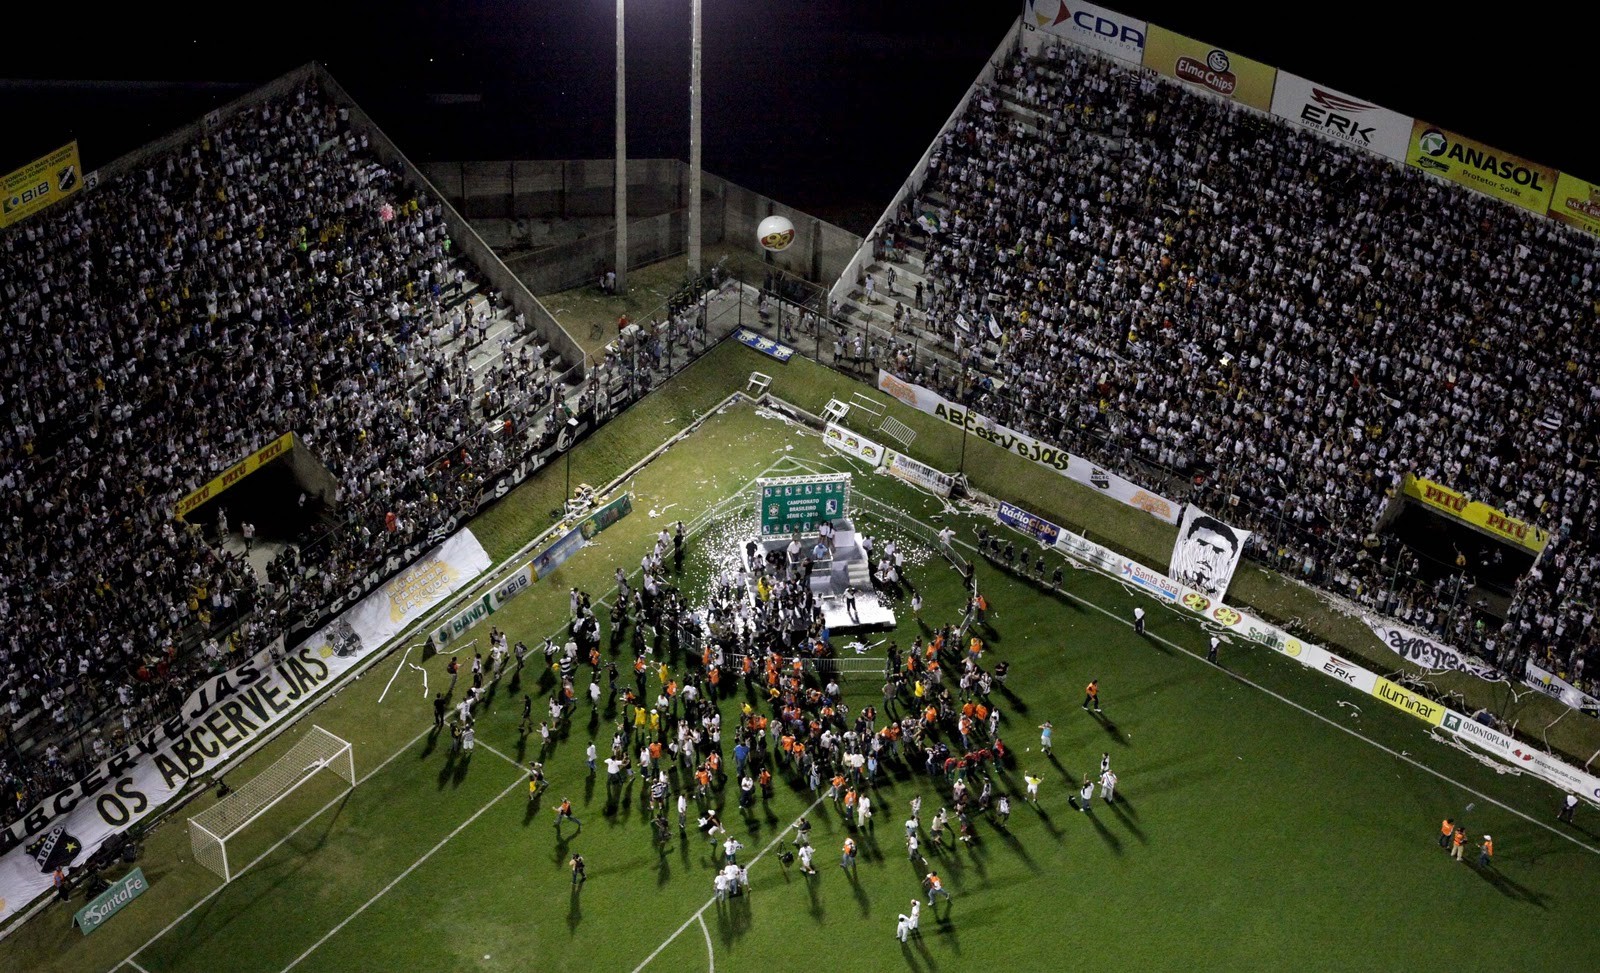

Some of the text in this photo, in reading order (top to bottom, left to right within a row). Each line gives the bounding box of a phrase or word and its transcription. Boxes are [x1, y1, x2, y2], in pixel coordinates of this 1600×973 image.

[1074, 10, 1145, 49] CDA
[1178, 60, 1234, 91] Elma Chips
[1300, 103, 1377, 144] ERK
[1301, 118, 1325, 132] SPORT
[1326, 128, 1370, 148] EVOLUTION
[1447, 143, 1543, 192] ANASOL
[21, 181, 50, 205] BiB
[1462, 169, 1522, 198] Protetor Solar
[767, 232, 793, 250] 98
[786, 498, 820, 506] CAMPEONATO
[330, 454, 546, 614] COMANO SUL
[387, 557, 441, 598] LIVRARIA
[507, 575, 527, 594] BiB
[1133, 566, 1158, 585] Santa
[1159, 579, 1179, 595] Sara
[399, 574, 450, 615] CASCUDO
[1184, 593, 1209, 612] 98
[453, 602, 487, 634] BAND
[1215, 607, 1240, 626] 98
[1323, 662, 1357, 683] ERK
[1527, 669, 1566, 695] iluminar
[1379, 682, 1437, 718] iluminar
[96, 648, 329, 827] OS ABCERVEJAS
[1462, 721, 1512, 750] ODONTOPLAN
[36, 841, 53, 867] ABC
